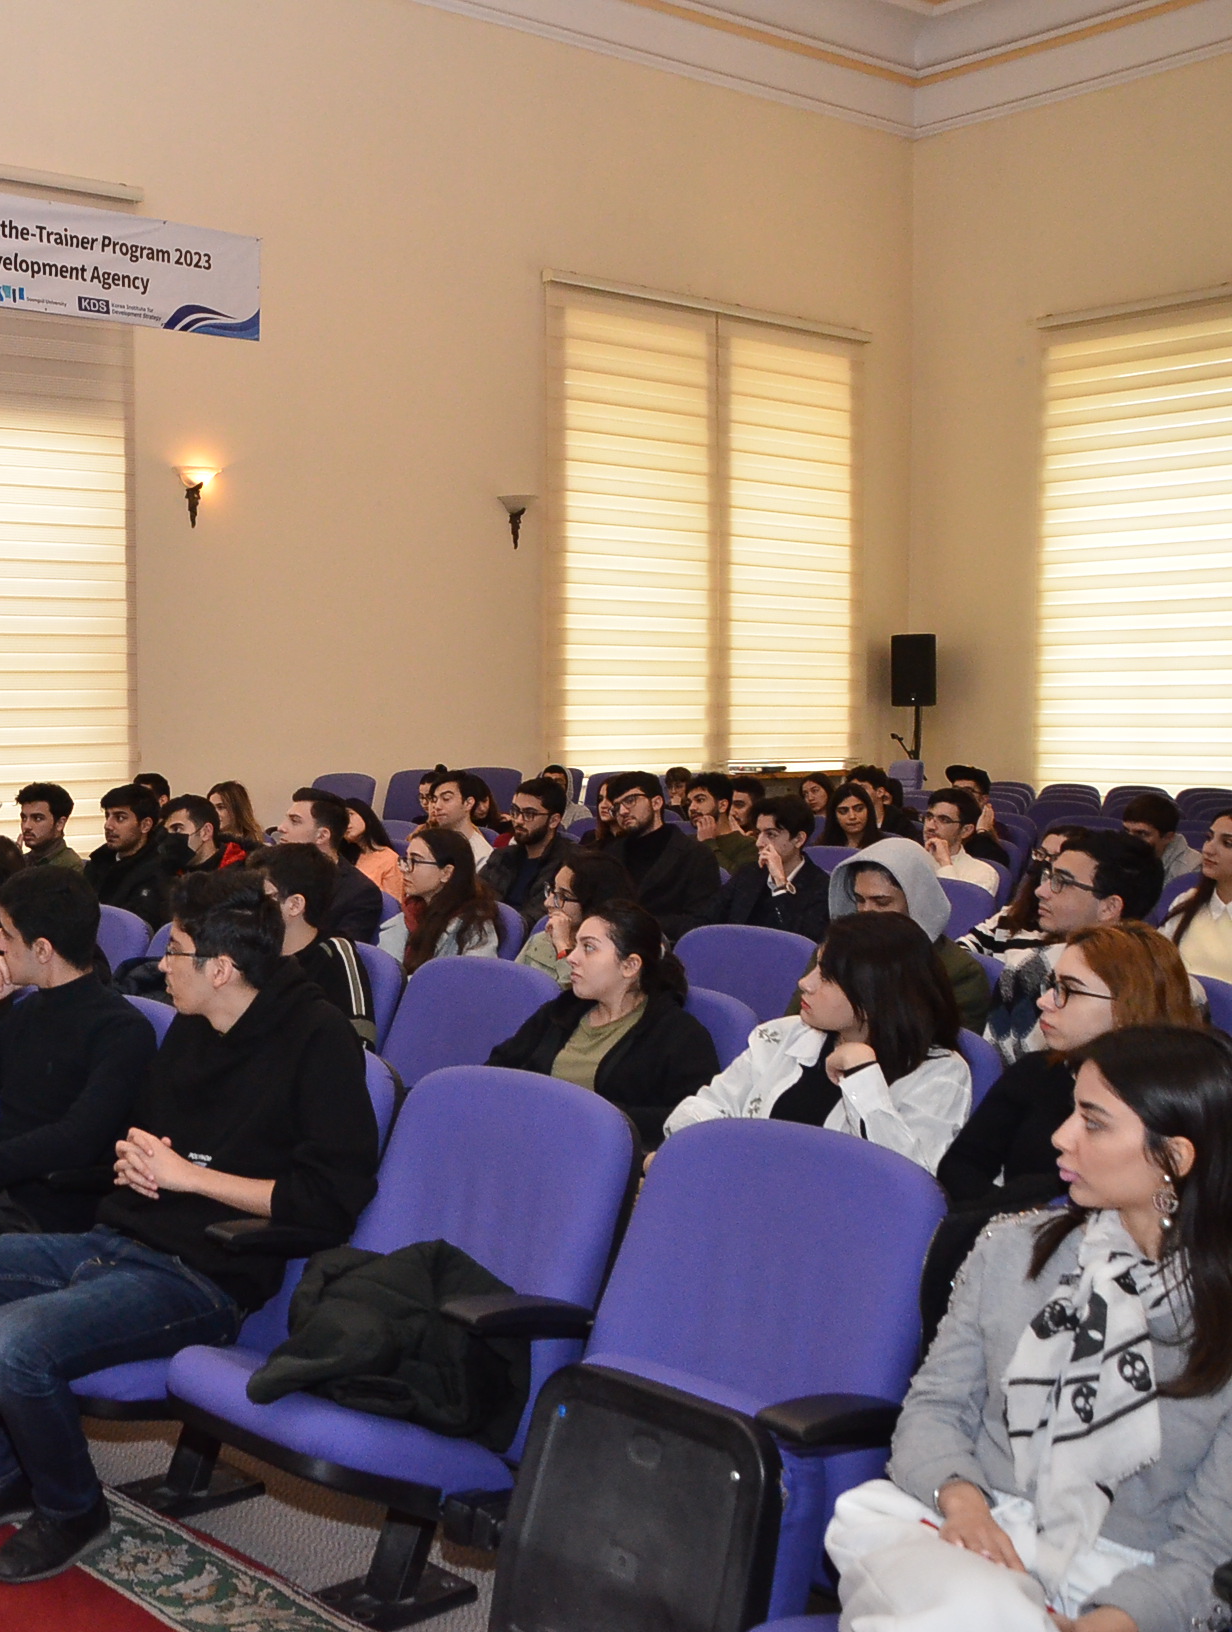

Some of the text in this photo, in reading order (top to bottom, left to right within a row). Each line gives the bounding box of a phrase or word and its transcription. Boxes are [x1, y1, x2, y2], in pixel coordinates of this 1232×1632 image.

[101, 235, 171, 264] Program
[174, 248, 212, 271] 2023
[89, 265, 150, 296] Agency
[81, 298, 107, 312] KDS
[112, 310, 143, 318] Development
